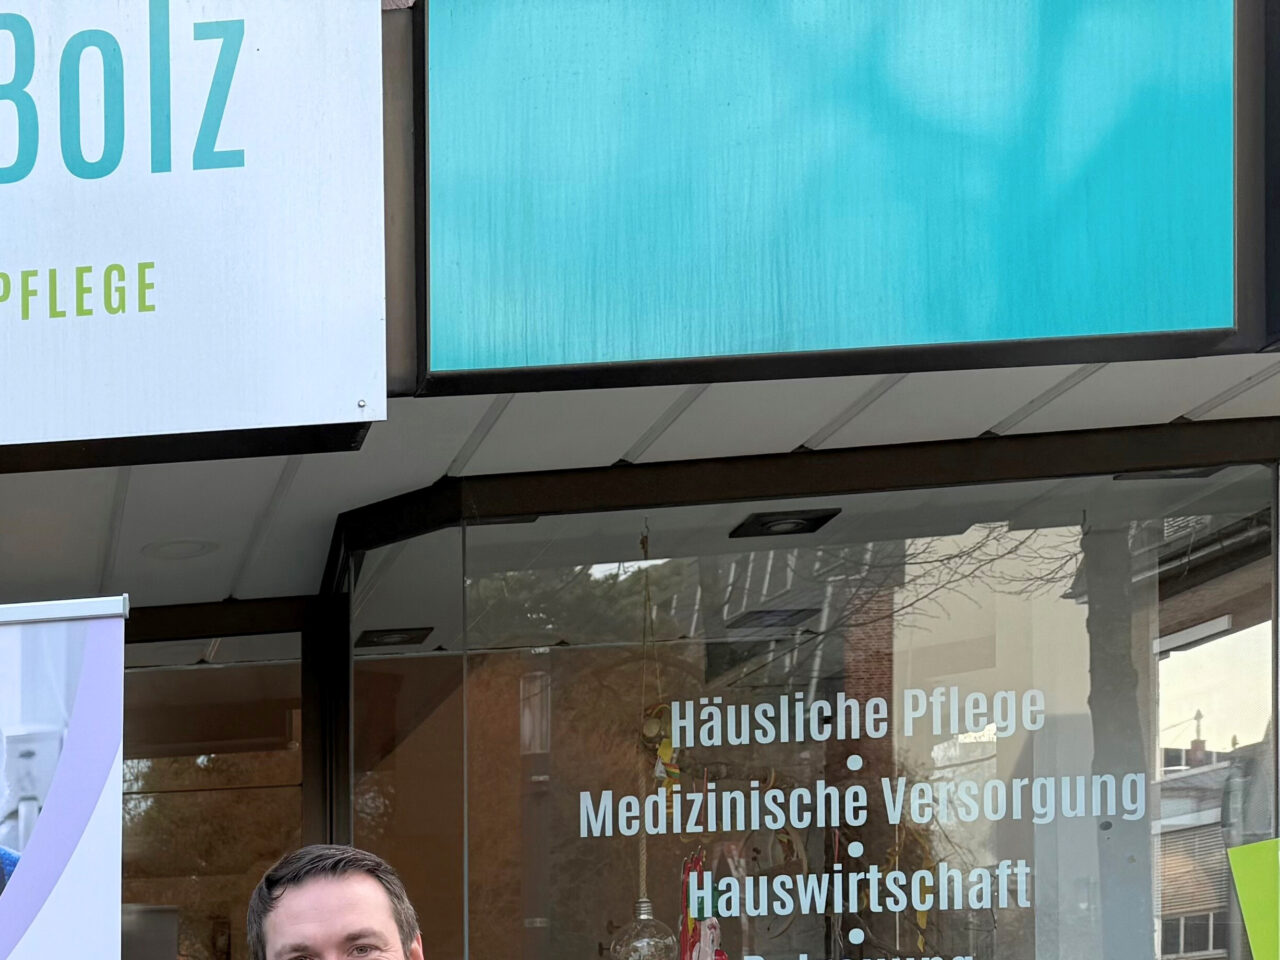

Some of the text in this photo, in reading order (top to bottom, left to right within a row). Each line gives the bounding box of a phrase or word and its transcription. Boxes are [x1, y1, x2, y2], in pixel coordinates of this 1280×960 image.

[672, 686, 1046, 748] Häusliche Pflege
[579, 772, 1146, 838] Medizinische Versorgung
[688, 859, 1031, 919] Hauswirtschaft
